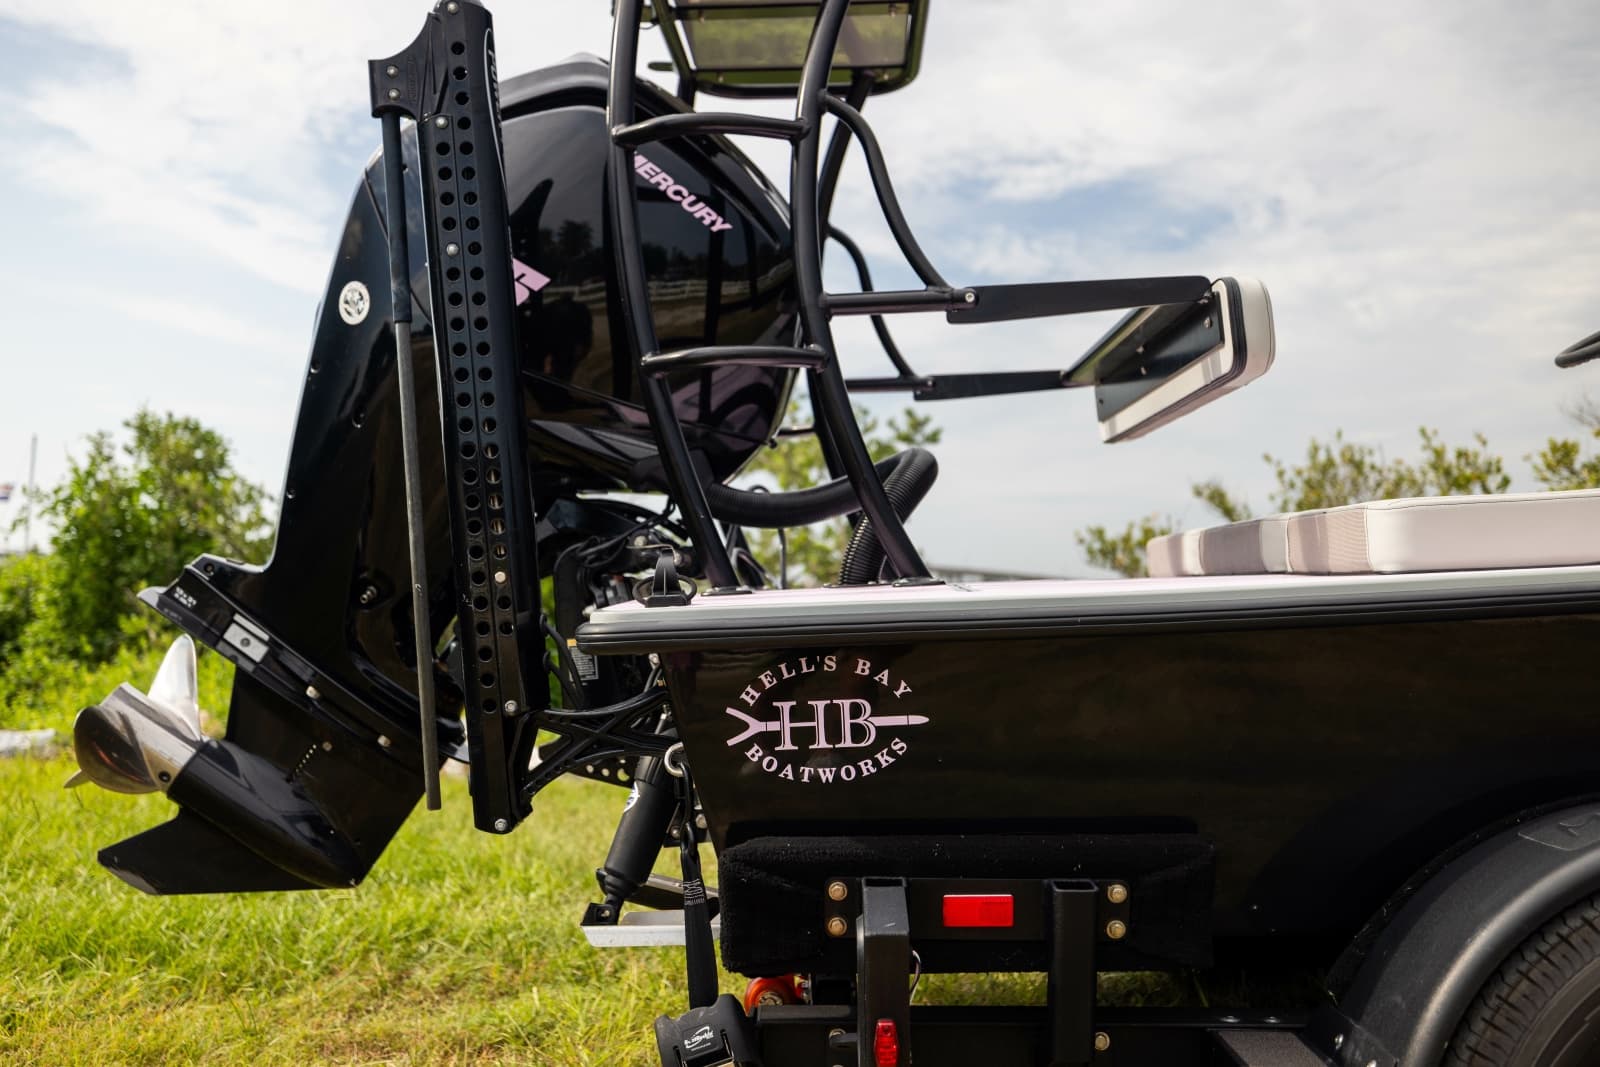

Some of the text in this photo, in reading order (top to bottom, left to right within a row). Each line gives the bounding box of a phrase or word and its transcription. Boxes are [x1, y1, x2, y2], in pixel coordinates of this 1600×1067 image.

[739, 655, 912, 706] HELL'S BAY
[772, 699, 876, 750] HB
[744, 737, 907, 783] BOATWORKS
